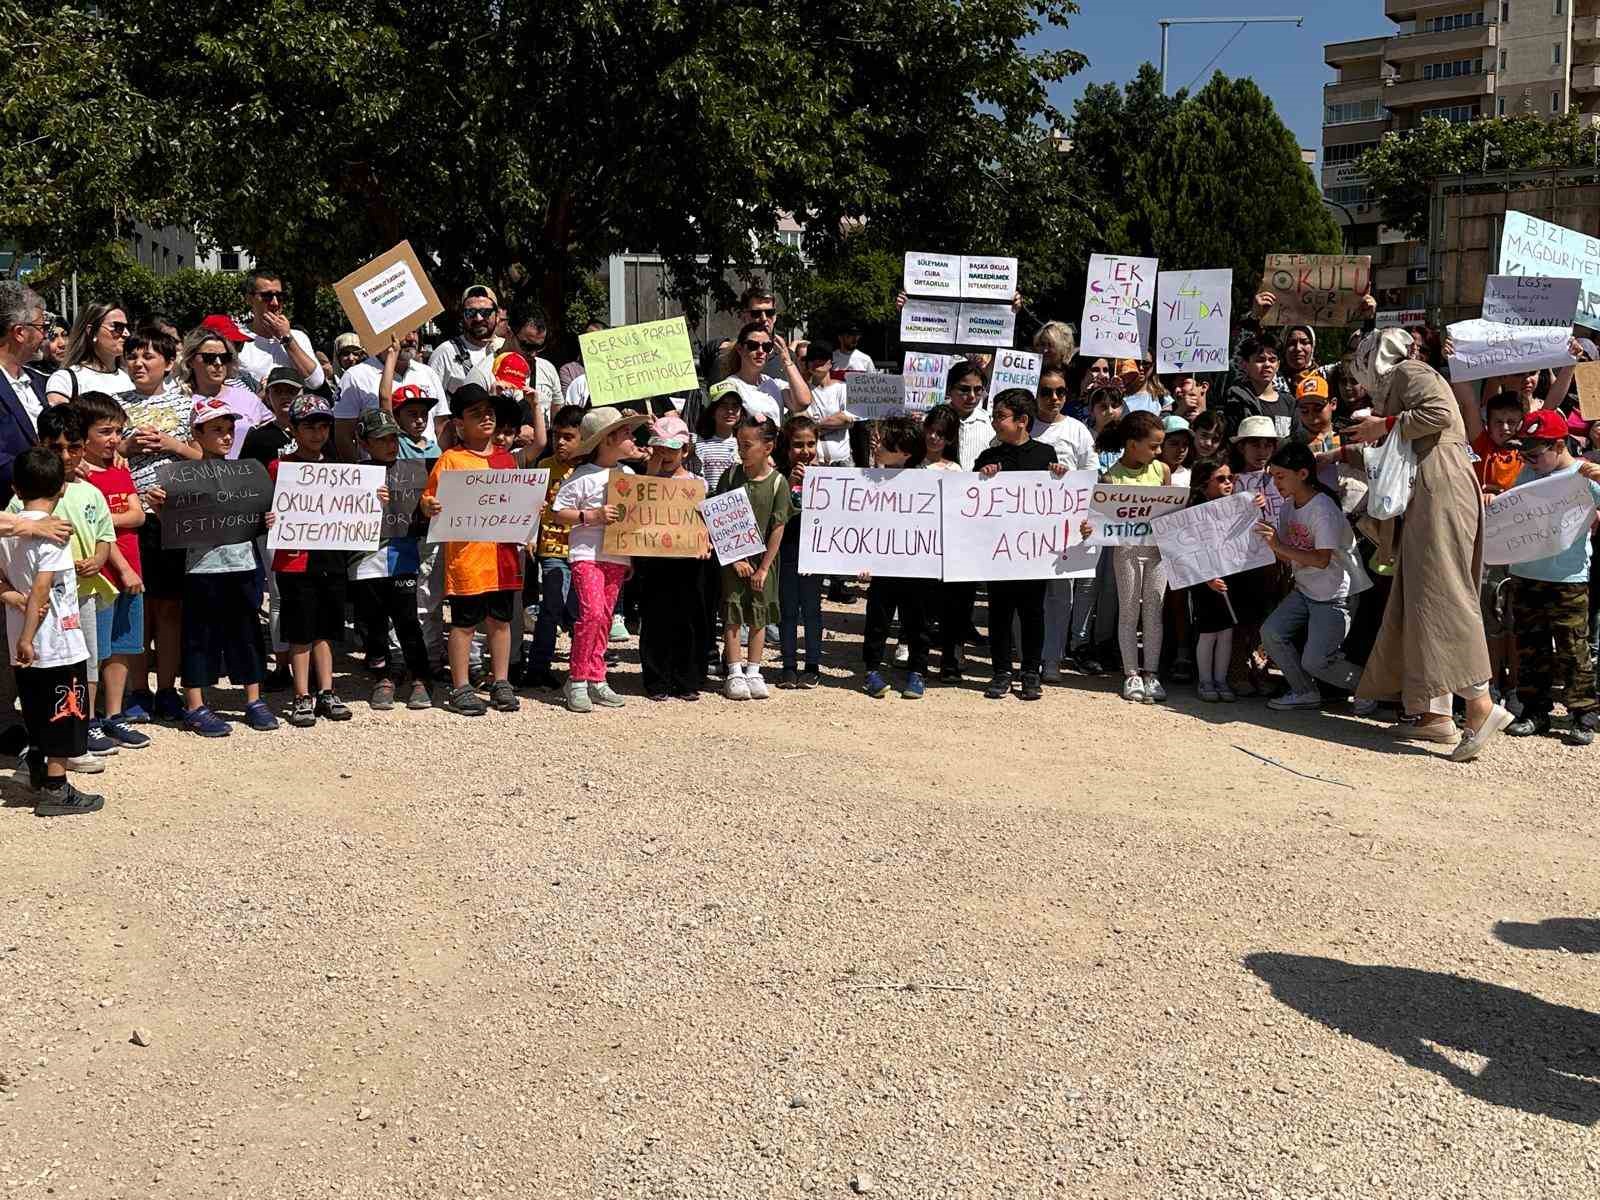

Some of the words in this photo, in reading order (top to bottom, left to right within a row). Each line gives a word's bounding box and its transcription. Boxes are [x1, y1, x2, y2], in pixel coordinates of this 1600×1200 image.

[1104, 257, 1144, 282] TEK
[1271, 265, 1371, 296] OKULU
[1177, 272, 1202, 297] 4
[1162, 299, 1224, 321] YILDA
[640, 321, 686, 341] PARASI
[606, 348, 662, 371] ÖDEMEK
[296, 464, 362, 487] BAŞKA
[216, 487, 261, 503] OKUL
[276, 491, 324, 516] OKULA
[328, 491, 382, 514] NAKİL
[636, 482, 678, 502] BEN
[805, 476, 832, 511] 15
[836, 477, 937, 515] TEMMUZ
[960, 487, 980, 518] 9
